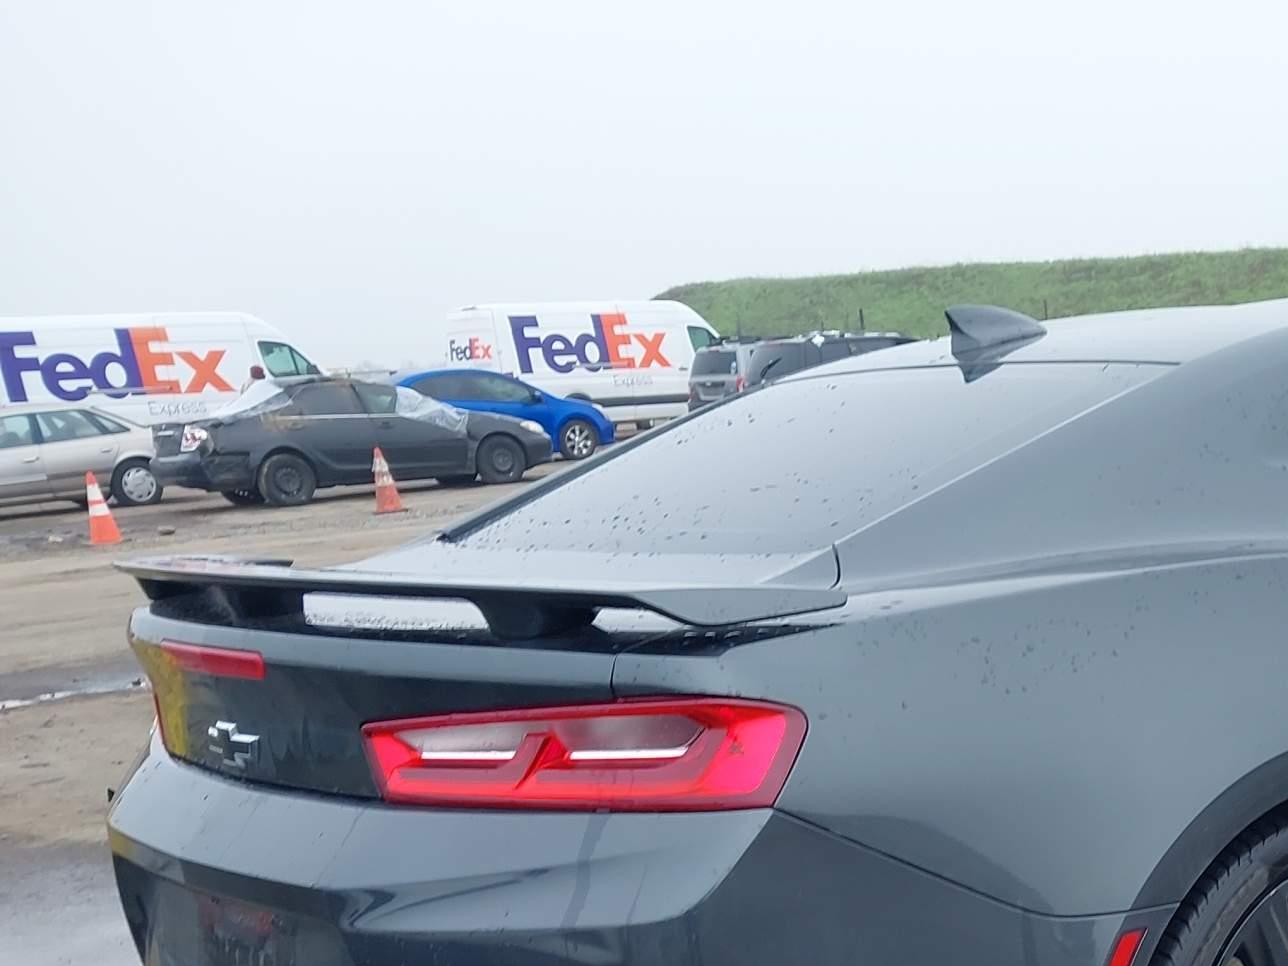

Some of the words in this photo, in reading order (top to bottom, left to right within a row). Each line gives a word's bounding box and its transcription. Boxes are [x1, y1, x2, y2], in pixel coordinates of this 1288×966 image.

[0, 326, 236, 402] FedEx
[449, 337, 492, 361] FedEx
[508, 313, 671, 373] FedEx
